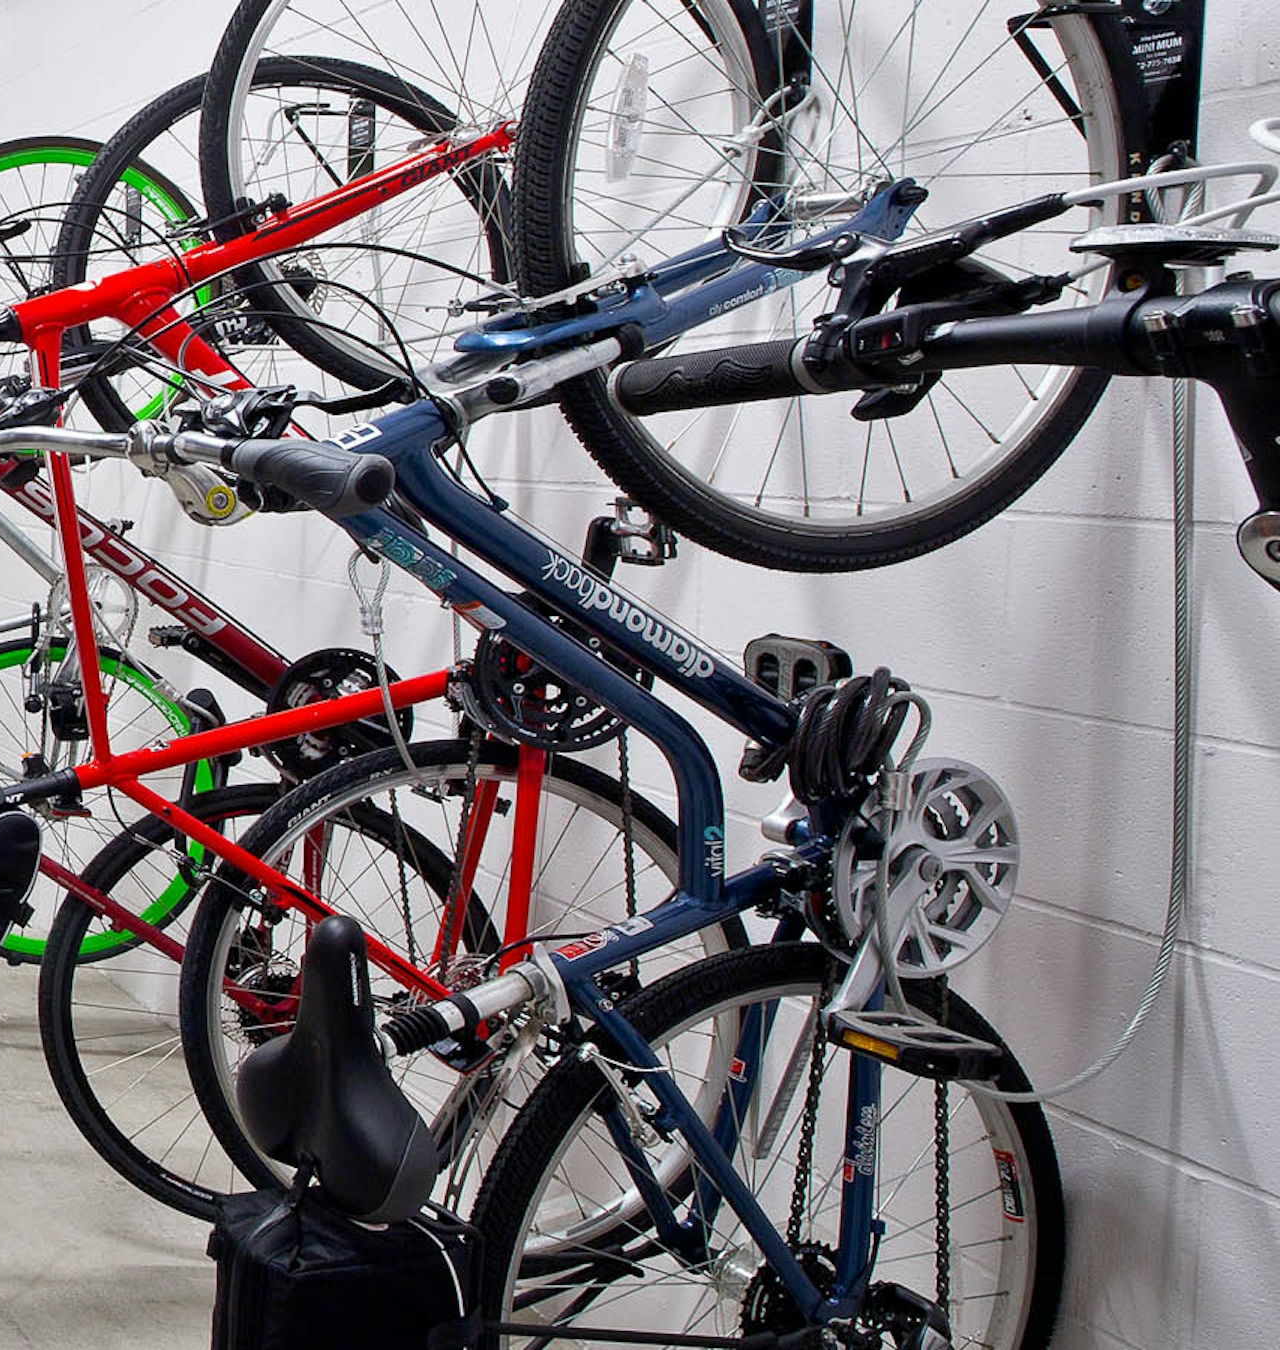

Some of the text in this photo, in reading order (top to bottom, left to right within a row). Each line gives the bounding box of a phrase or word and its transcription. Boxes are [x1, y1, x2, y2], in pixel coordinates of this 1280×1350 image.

[401, 144, 473, 186] GIANT
[723, 284, 764, 311] comfort
[15, 479, 228, 636] FOCUS
[541, 549, 716, 679] diamondback
